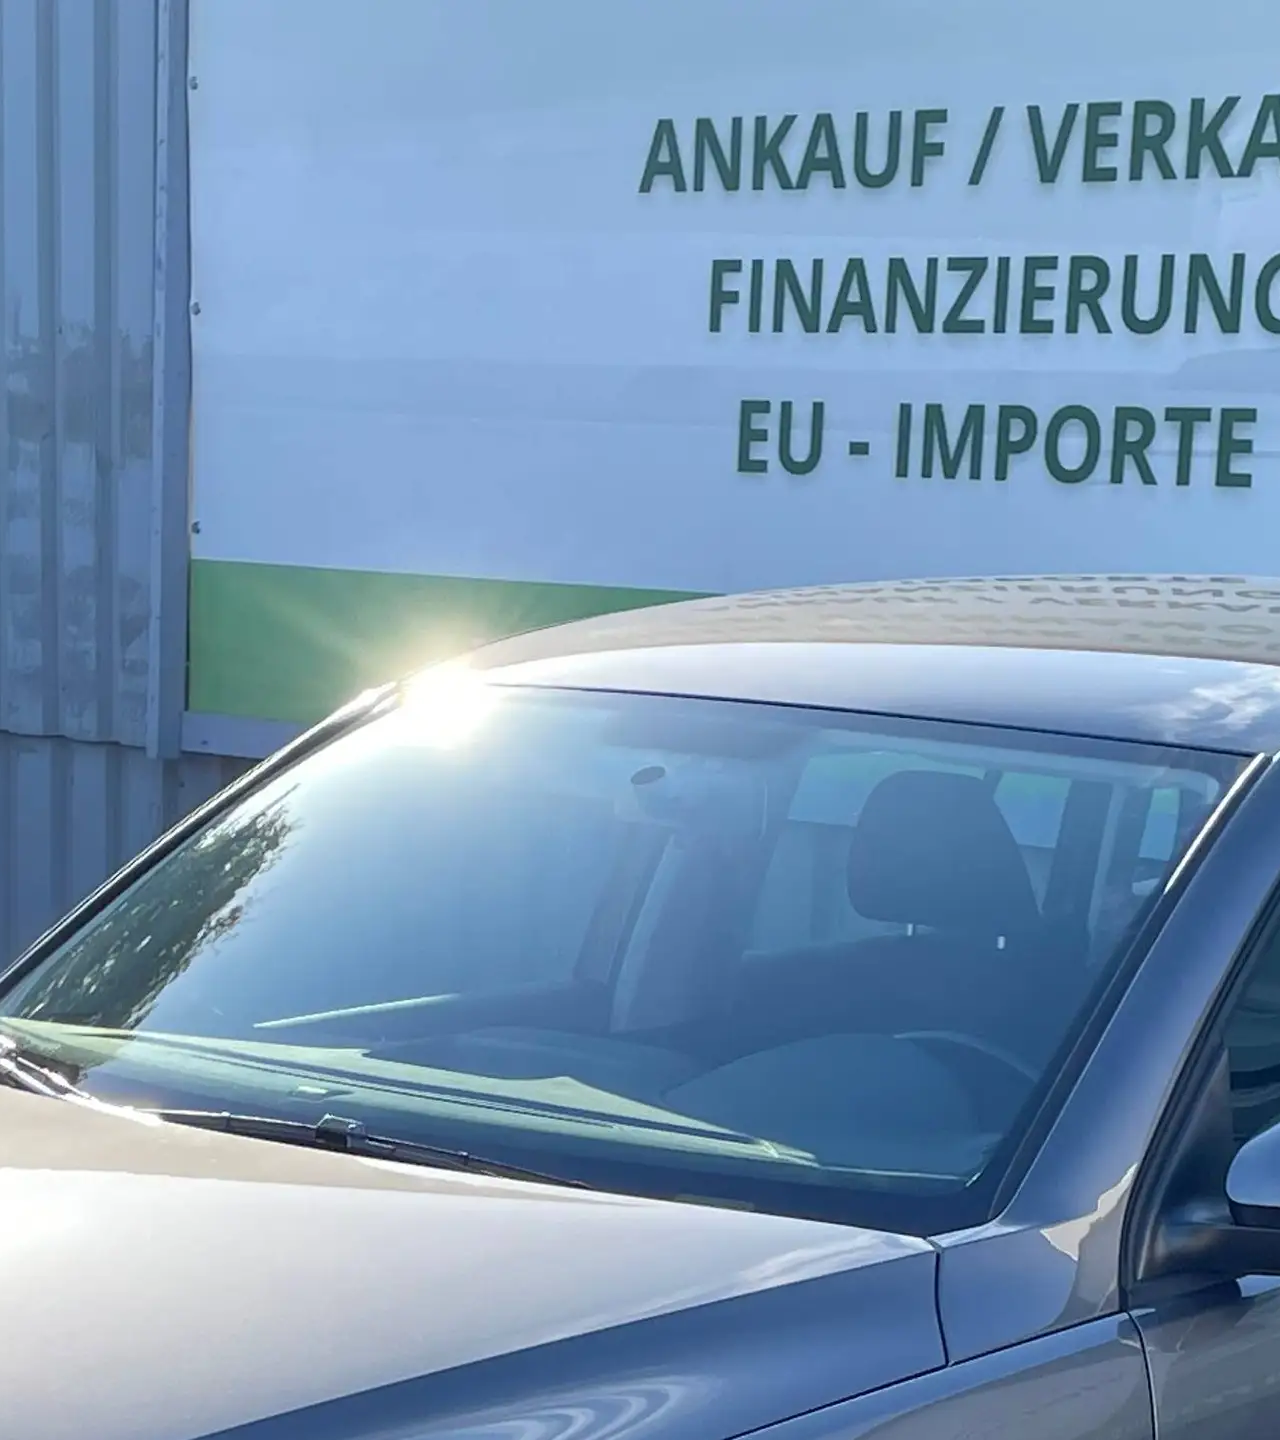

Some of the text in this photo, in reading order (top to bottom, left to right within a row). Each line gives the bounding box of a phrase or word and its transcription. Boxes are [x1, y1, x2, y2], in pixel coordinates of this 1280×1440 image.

[638, 108, 949, 194] ANKAUF
[967, 106, 1006, 187] /
[736, 399, 1258, 488] EU - IMPORTE
